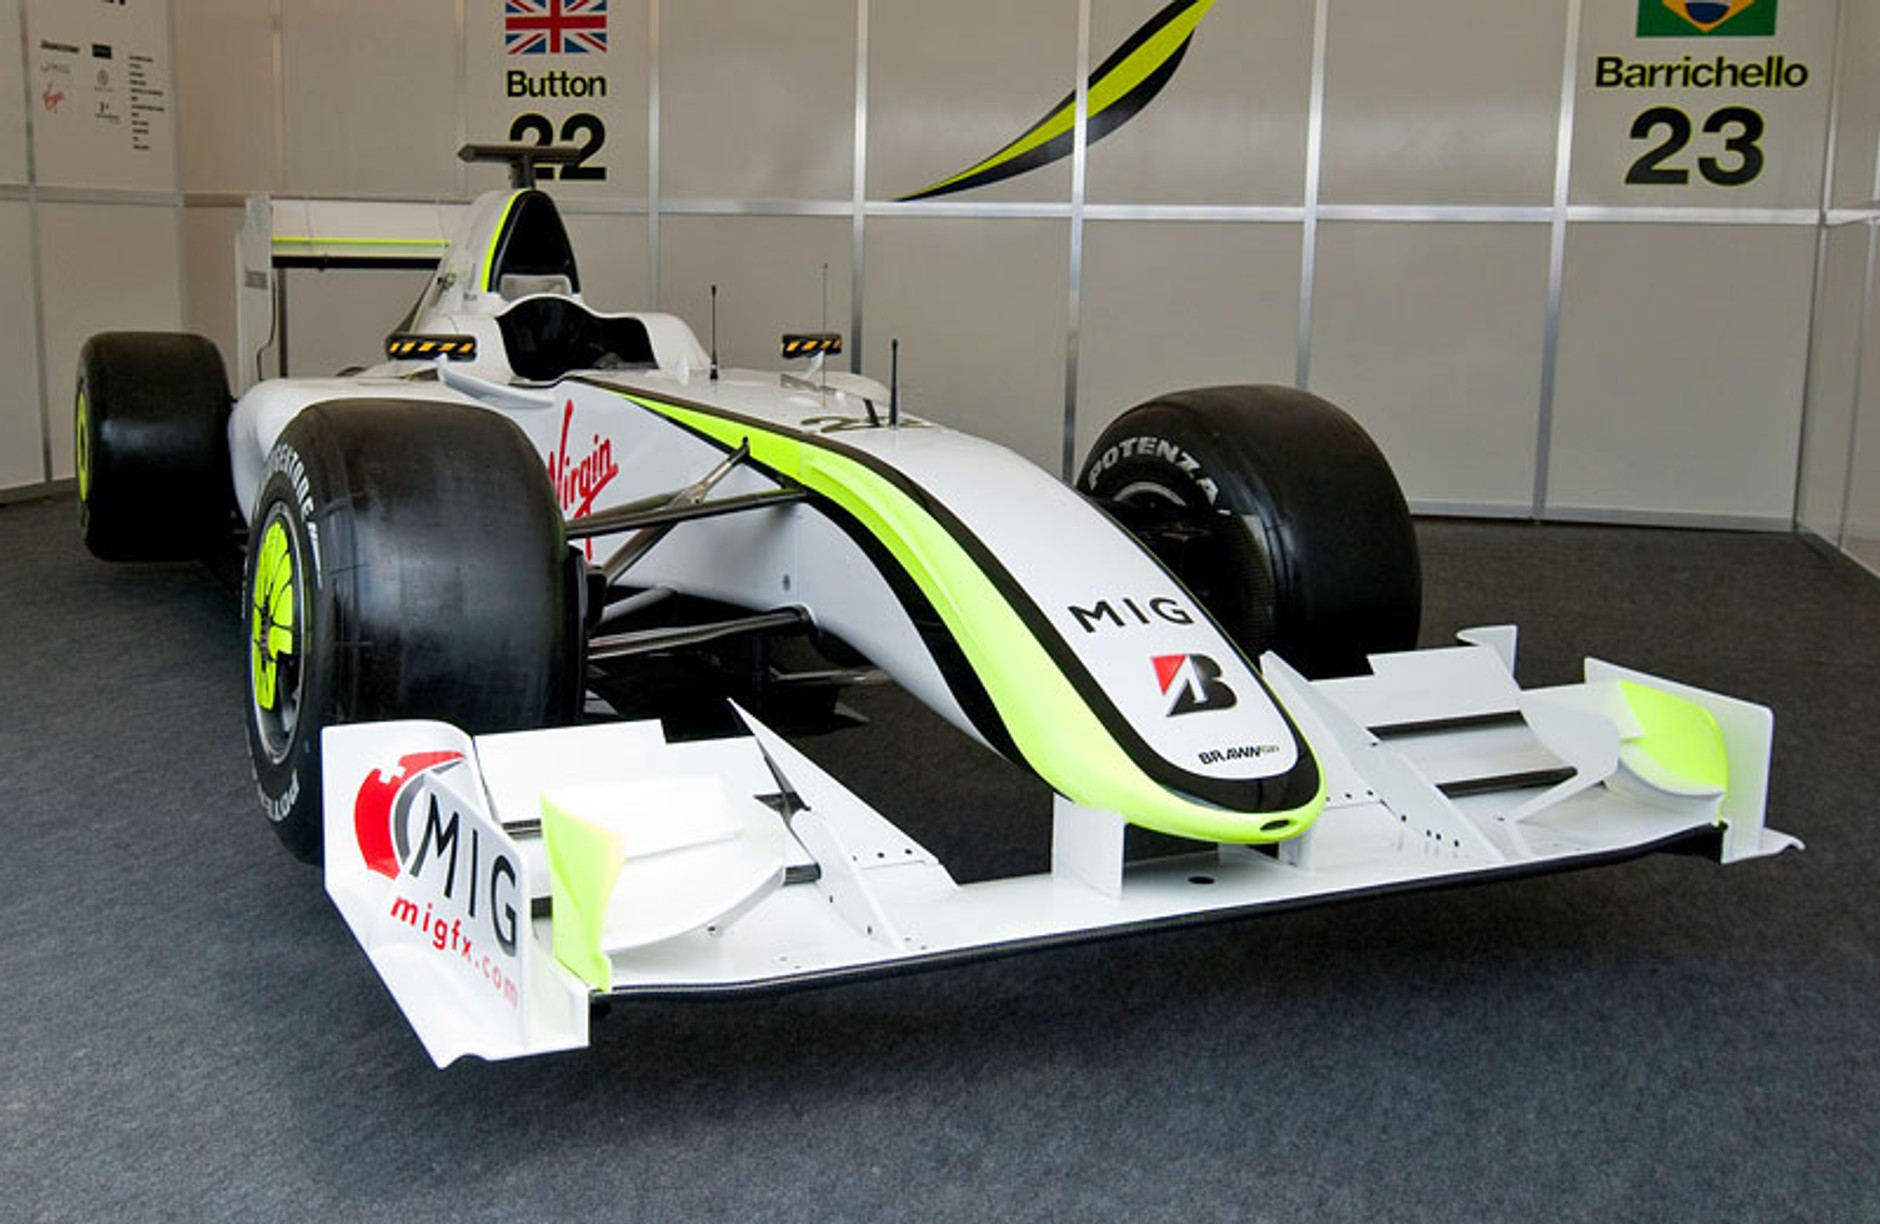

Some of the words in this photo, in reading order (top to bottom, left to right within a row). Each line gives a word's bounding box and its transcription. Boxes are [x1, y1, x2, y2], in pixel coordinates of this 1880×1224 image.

[507, 70, 606, 97] Button
[1596, 55, 1808, 88] Barrichello
[509, 113, 607, 180] 22
[1625, 106, 1763, 186] 23
[548, 399, 619, 562] Virgin
[1088, 436, 1219, 506] POTENZA
[1067, 597, 1194, 633] MIG
[409, 792, 517, 958] MIG
[390, 896, 519, 1009] migfx.com
